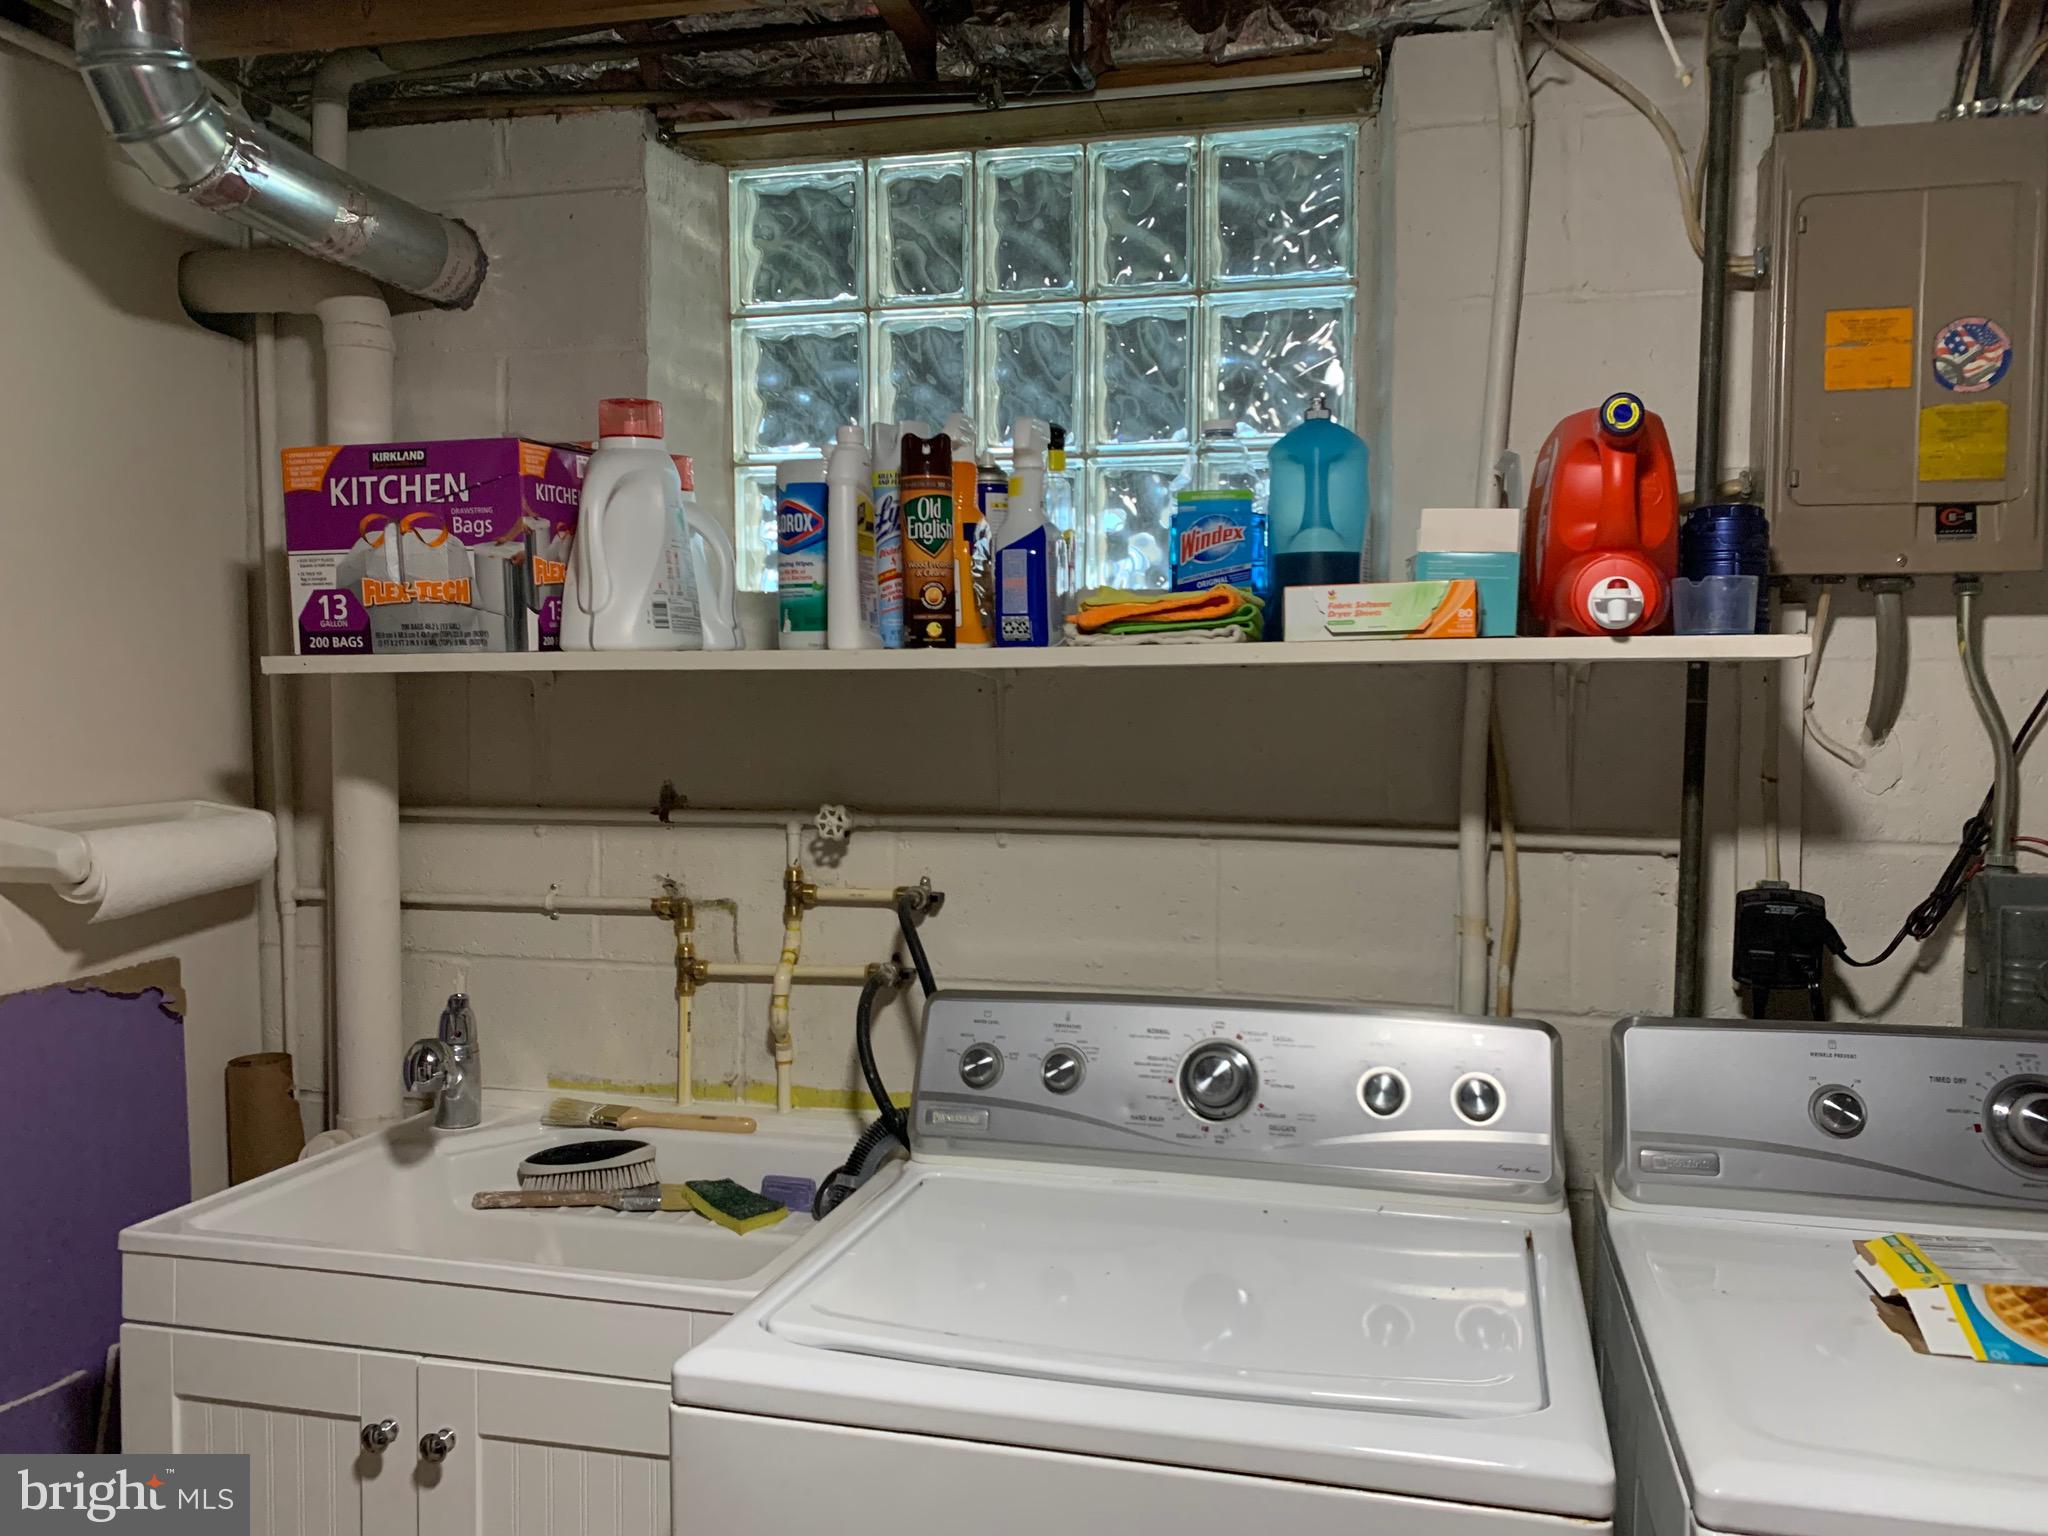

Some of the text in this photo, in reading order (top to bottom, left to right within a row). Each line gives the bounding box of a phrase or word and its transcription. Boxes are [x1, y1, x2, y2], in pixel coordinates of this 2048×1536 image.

[372, 450, 425, 462] KIRKLAND
[329, 472, 470, 507] KITCHEN
[450, 506, 493, 515] DRAWSTRING
[917, 496, 942, 521] Old
[452, 516, 493, 538] Bags
[778, 512, 813, 533] OROX
[907, 515, 953, 545] English
[1180, 524, 1248, 566] Windex
[361, 577, 472, 607] FLEX-TECH
[1196, 576, 1229, 589] ORIGINAL
[318, 594, 348, 620] 13
[1457, 608, 1473, 618] 80
[320, 620, 348, 628] GALLON
[309, 636, 330, 648] 200
[332, 636, 364, 648] BAGS
[1929, 1075, 1949, 1084] TIMED
